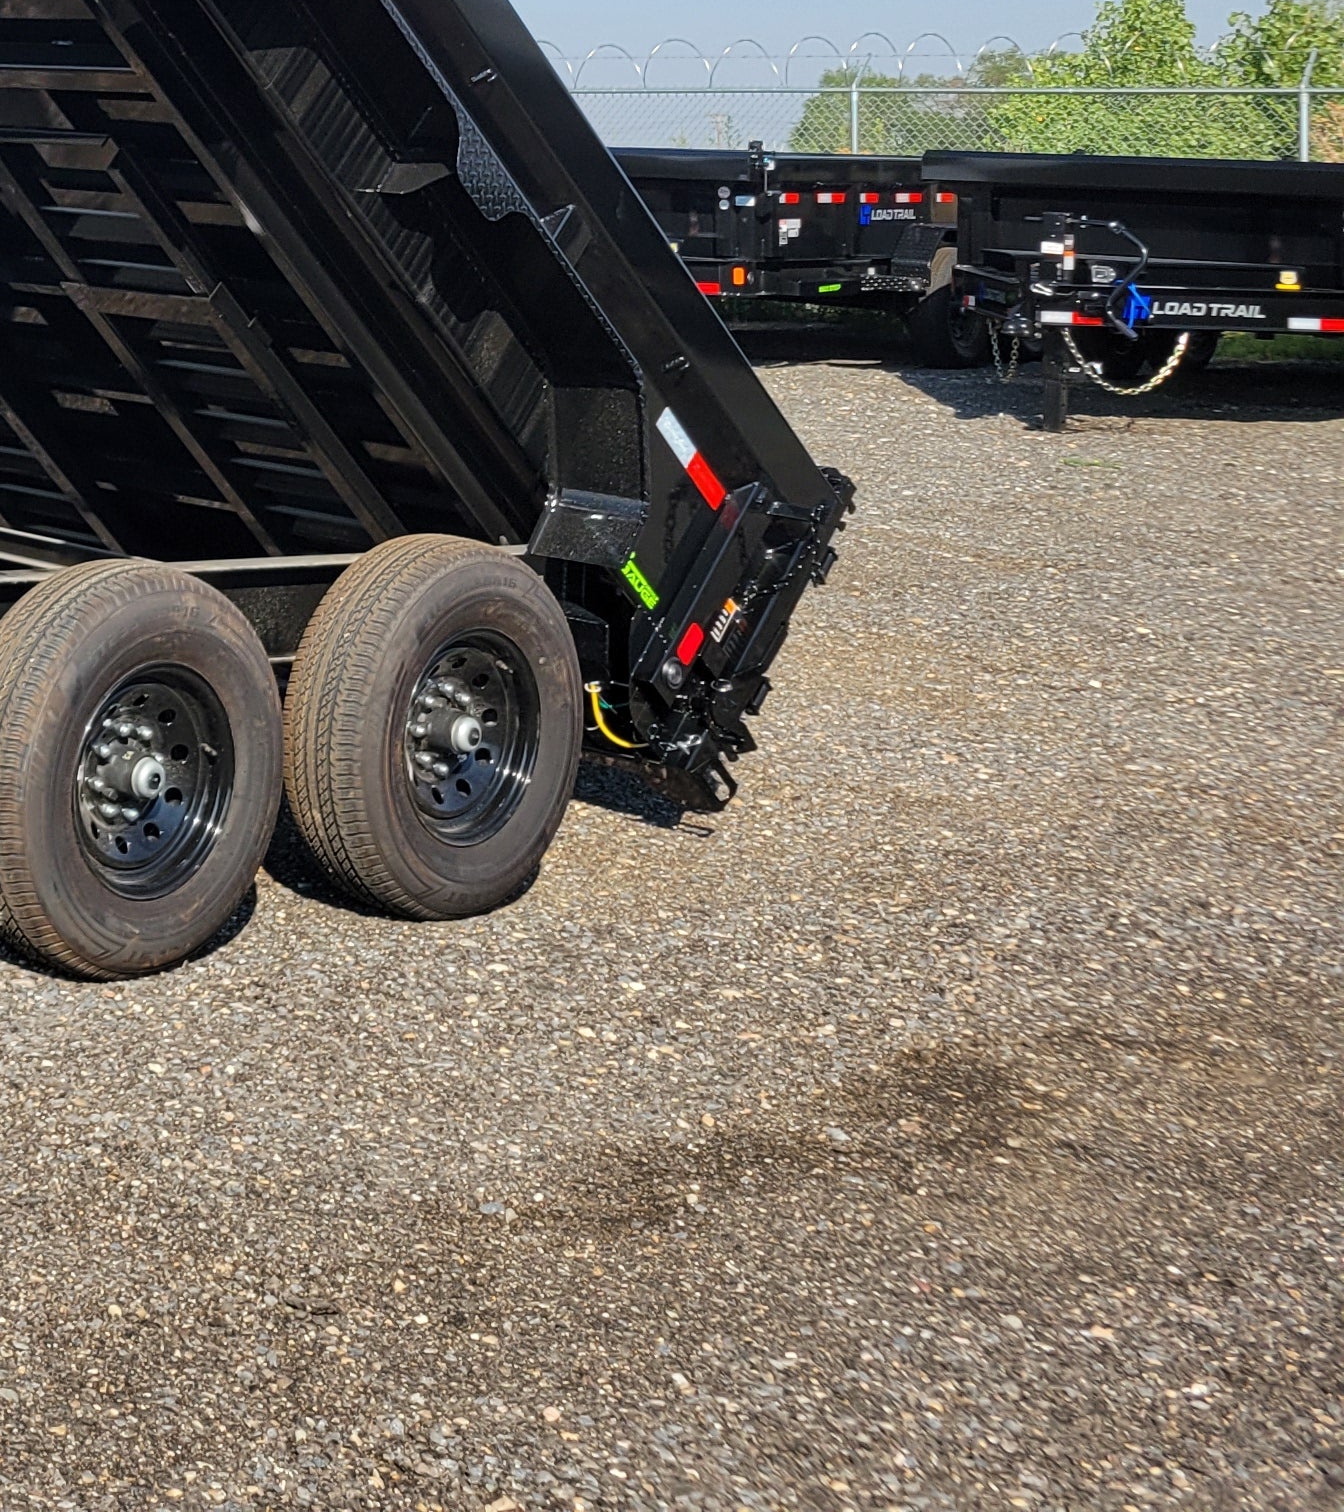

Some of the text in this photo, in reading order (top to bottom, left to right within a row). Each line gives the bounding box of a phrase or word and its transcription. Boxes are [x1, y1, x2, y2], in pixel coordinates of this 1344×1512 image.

[871, 208, 916, 221] LOAD TRAIL
[1152, 301, 1266, 319] LOAD TRAIL
